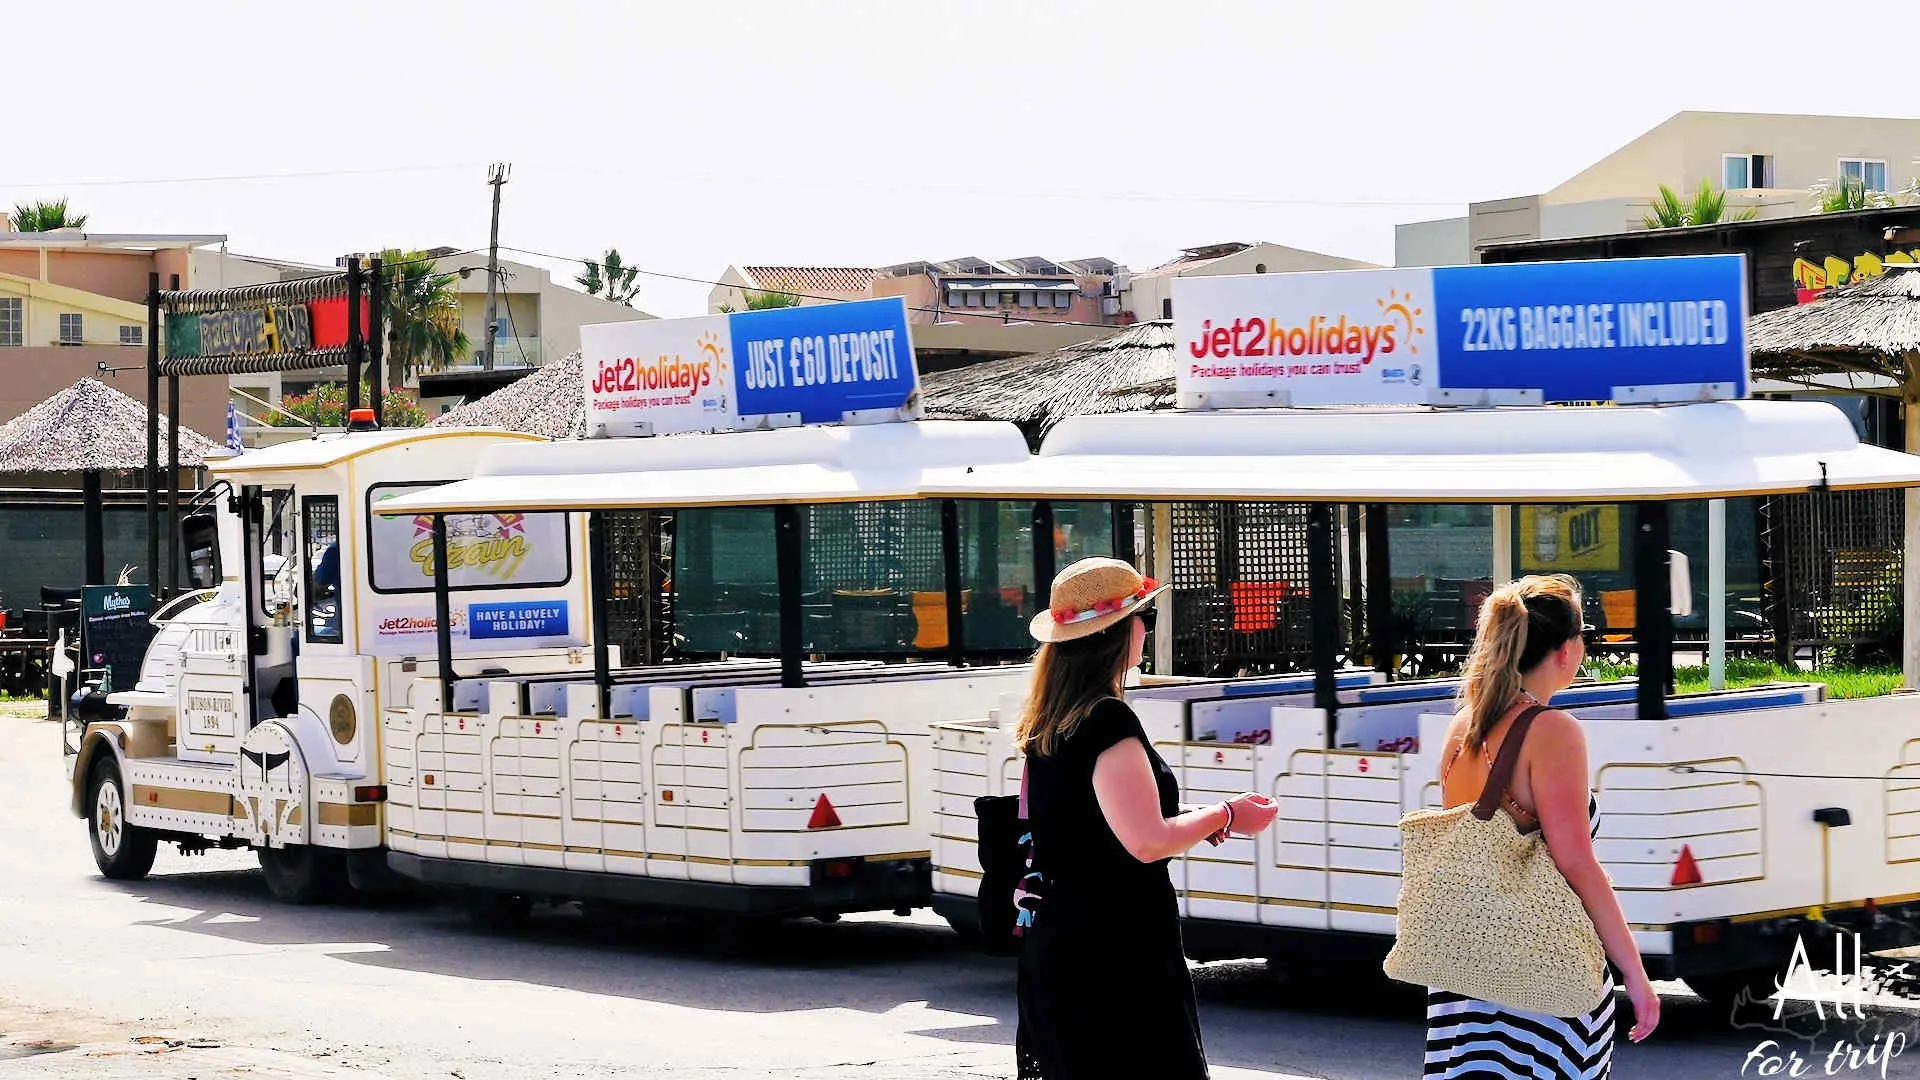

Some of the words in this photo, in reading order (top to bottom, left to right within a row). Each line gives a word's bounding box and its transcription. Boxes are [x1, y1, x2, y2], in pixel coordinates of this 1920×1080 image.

[274, 304, 311, 351] PUB
[1190, 315, 1396, 365] jet2holidays
[1461, 306, 1516, 351] 22KG
[1521, 303, 1616, 350] BAGGAGE
[1619, 299, 1729, 347] INCLUDED
[592, 353, 711, 397] jet2holidays
[745, 340, 785, 390] JUST
[790, 336, 826, 387] £60
[829, 329, 899, 382] DEPOSIT
[1190, 364, 1237, 379] Package
[1239, 363, 1285, 378] holidays
[1287, 364, 1306, 378] you
[1310, 363, 1330, 375] can
[1334, 361, 1362, 374] trust
[592, 399, 620, 411] Package
[621, 396, 647, 410] holidays
[648, 398, 660, 408] you
[662, 397, 673, 406] can
[476, 610, 506, 621] HAVE
[508, 610, 517, 620] A
[518, 607, 561, 619] LOVELY
[492, 619, 546, 631] HOLIDAY!
